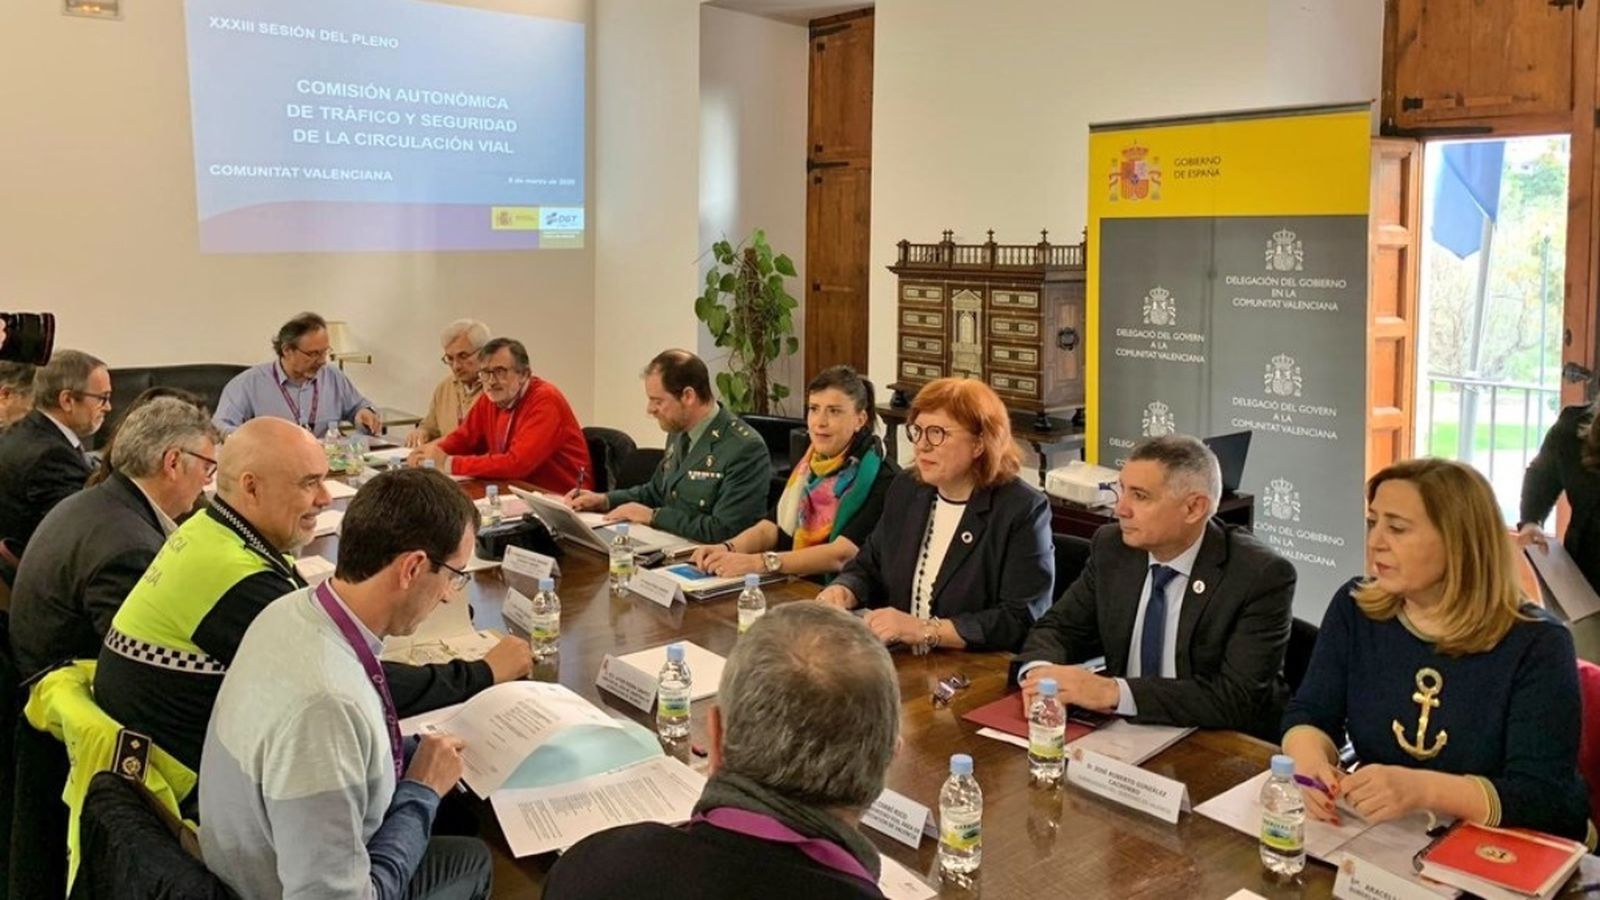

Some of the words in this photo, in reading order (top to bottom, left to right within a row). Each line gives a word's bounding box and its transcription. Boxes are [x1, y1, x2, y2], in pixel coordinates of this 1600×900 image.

[209, 16, 254, 33] XXXIII
[259, 21, 315, 40] SESIÓN
[320, 29, 348, 44] DEL
[353, 33, 399, 49] PLENO
[297, 79, 391, 101] COMISIÓN
[397, 87, 509, 110] AUTONÓMICA
[287, 104, 313, 119] DE
[320, 104, 400, 124] TRÁFICO
[405, 113, 416, 125] Y
[421, 114, 517, 133] SEGURIDAD
[293, 129, 320, 143] DE
[326, 131, 350, 145] LA
[354, 132, 473, 152] CIRCULACIÓN
[478, 139, 514, 154] VIAL
[1174, 156, 1221, 167] GOBIERNO
[209, 164, 300, 179] COMUNITAT
[303, 168, 393, 182] VALENCIANA
[1174, 170, 1184, 179] DE
[1188, 168, 1220, 178] ESPAÑA
[1226, 275, 1279, 286] DELEGACIÓN
[1280, 277, 1296, 287] DEL
[1299, 278, 1347, 289] GOBIERNO
[1272, 289, 1283, 298] EN
[1285, 289, 1296, 298] LA
[1232, 297, 1281, 308] COMUNITAT
[1282, 300, 1339, 311] VALENCIANA
[1116, 328, 1156, 339] DELEGACIÓ
[1157, 331, 1171, 340] DEL
[1172, 332, 1204, 342] GOVERN
[1150, 341, 1156, 349] A
[1157, 341, 1168, 350] LA
[1115, 348, 1156, 358] COMUNITAT
[1157, 351, 1205, 363] VALENCIANA
[1232, 397, 1279, 410] DELEGACIÓ
[1280, 402, 1297, 413] DEL
[1298, 404, 1337, 417] GOVERN
[1273, 413, 1279, 421] A
[1281, 414, 1293, 424] LA
[1231, 418, 1280, 432] COMUNITAT
[1281, 425, 1338, 440] VALENCIANA
[1270, 534, 1281, 544] EN
[1282, 538, 1294, 547] LA
[1279, 526, 1294, 537] DEL
[1296, 529, 1344, 546] GOBIERNO
[1280, 549, 1337, 568] VALENCIANA
